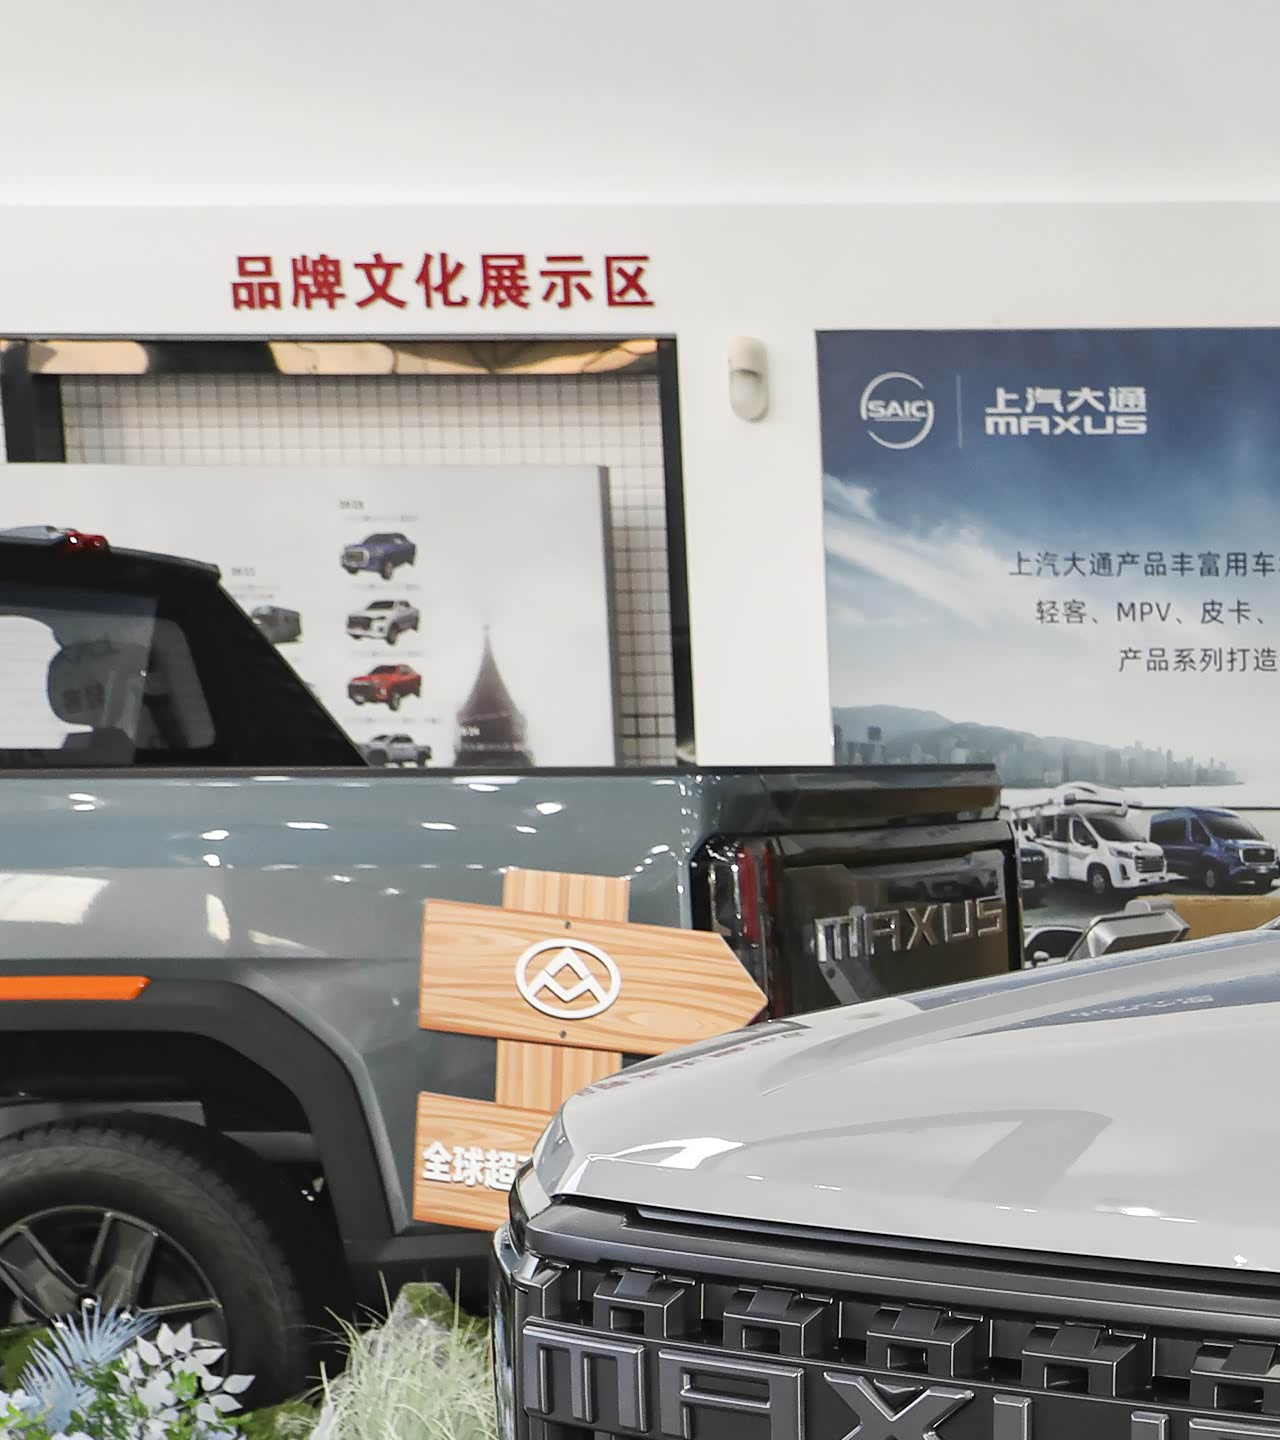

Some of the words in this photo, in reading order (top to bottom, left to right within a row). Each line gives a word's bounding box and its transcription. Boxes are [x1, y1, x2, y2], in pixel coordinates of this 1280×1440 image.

[231, 252, 656, 310] 品牌文化展示区
[866, 399, 930, 418] SAIC
[984, 386, 1147, 414] 上汽大通
[984, 415, 1147, 436] MAXUS
[814, 895, 1004, 963] MAXUS
[422, 1140, 531, 1191] 全球超
